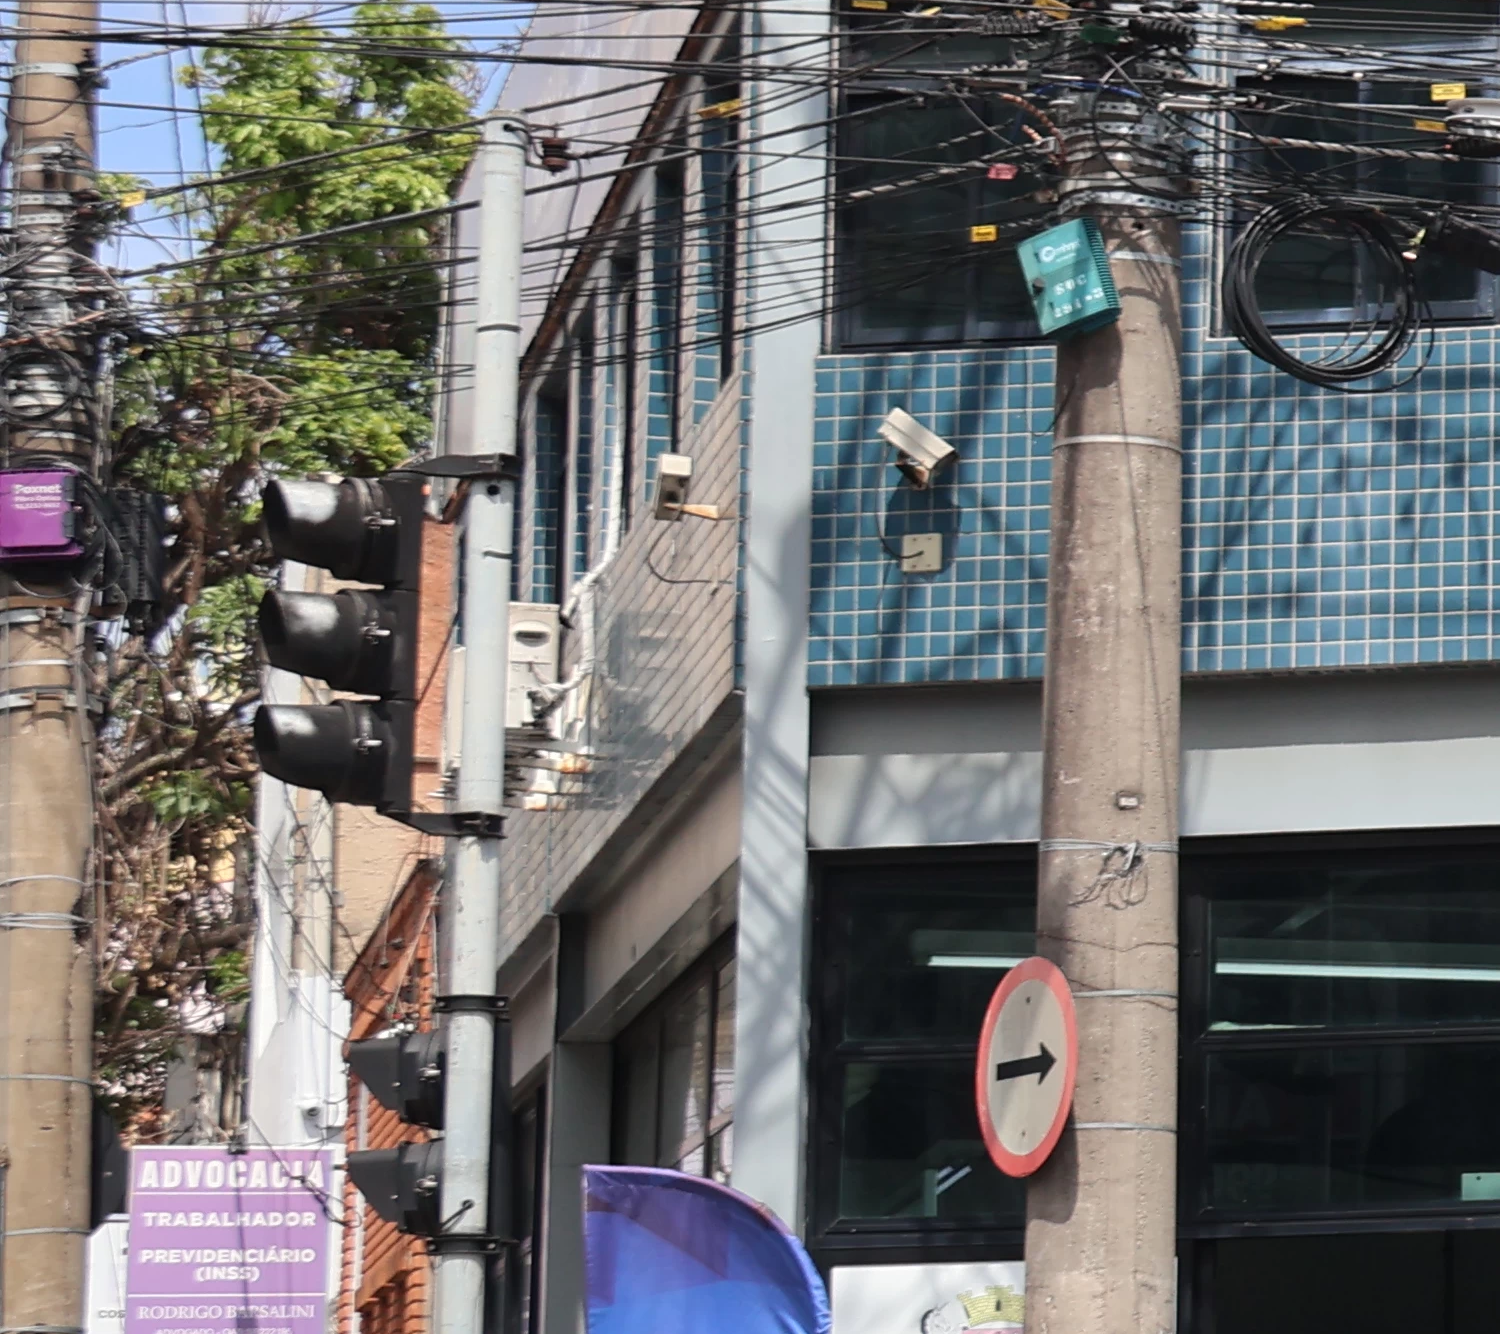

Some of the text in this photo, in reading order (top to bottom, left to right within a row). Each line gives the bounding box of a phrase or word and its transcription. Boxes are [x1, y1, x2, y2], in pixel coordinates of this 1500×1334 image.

[141, 1159, 325, 1189] ADVOCACIA
[142, 1212, 317, 1228] TRABALHADOR
[140, 1245, 317, 1264] PREVIDENCIÁRIO
[194, 1266, 261, 1282] (INSS)
[138, 1305, 223, 1320] RODRIGO
